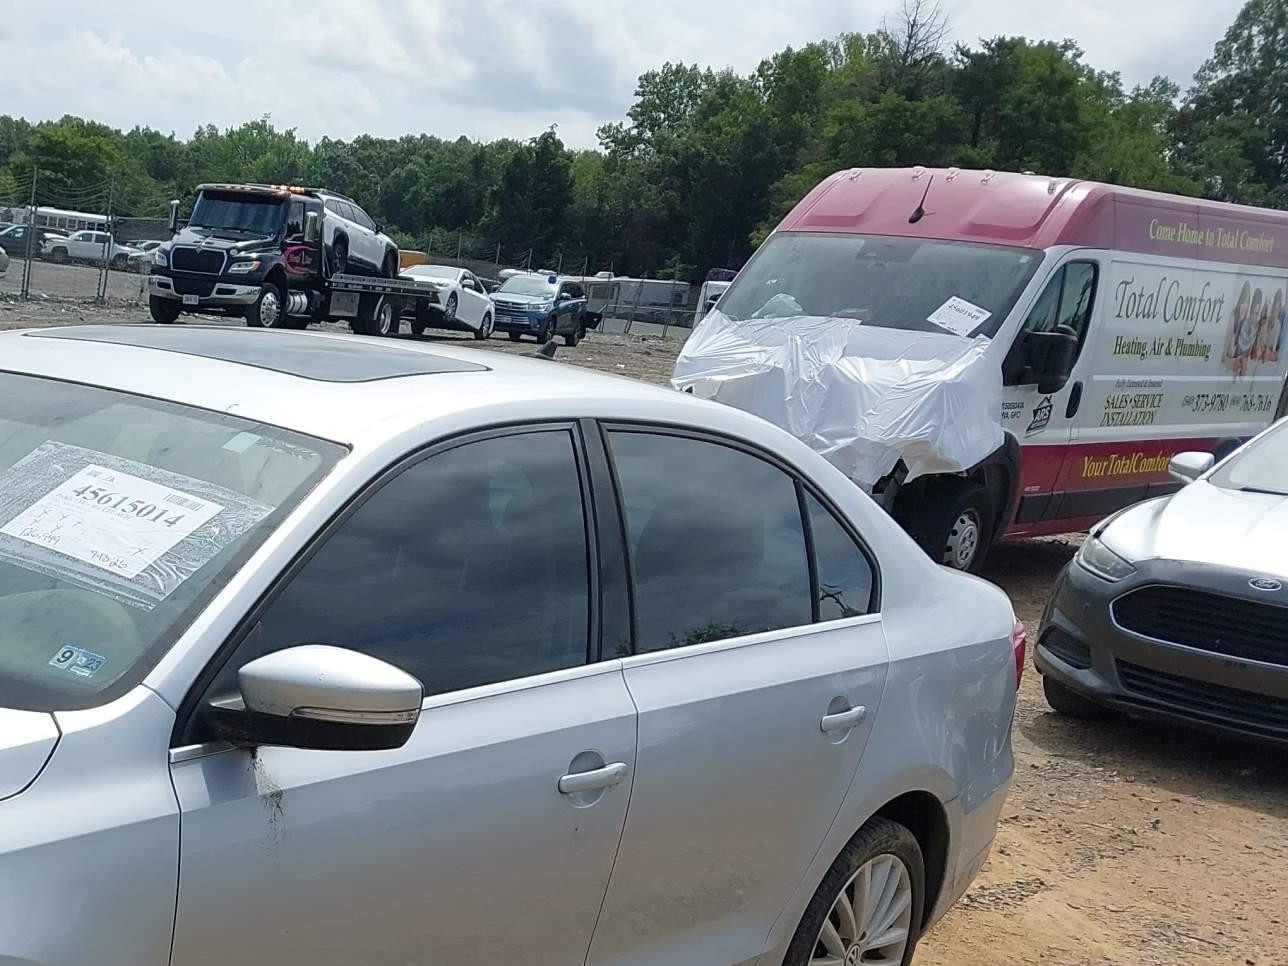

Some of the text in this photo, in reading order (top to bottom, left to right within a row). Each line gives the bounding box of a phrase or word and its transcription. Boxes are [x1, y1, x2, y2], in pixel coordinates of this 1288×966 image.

[1149, 218, 1275, 253] Come Home to Total Comfort
[1114, 275, 1225, 335] Total Comfort
[1113, 335, 1212, 362] Heating, Air & Plumbing
[1033, 406, 1050, 422] ARS
[1099, 410, 1158, 427] INSTALLATION
[72, 484, 185, 527] 45615014
[56, 649, 74, 663] 9
